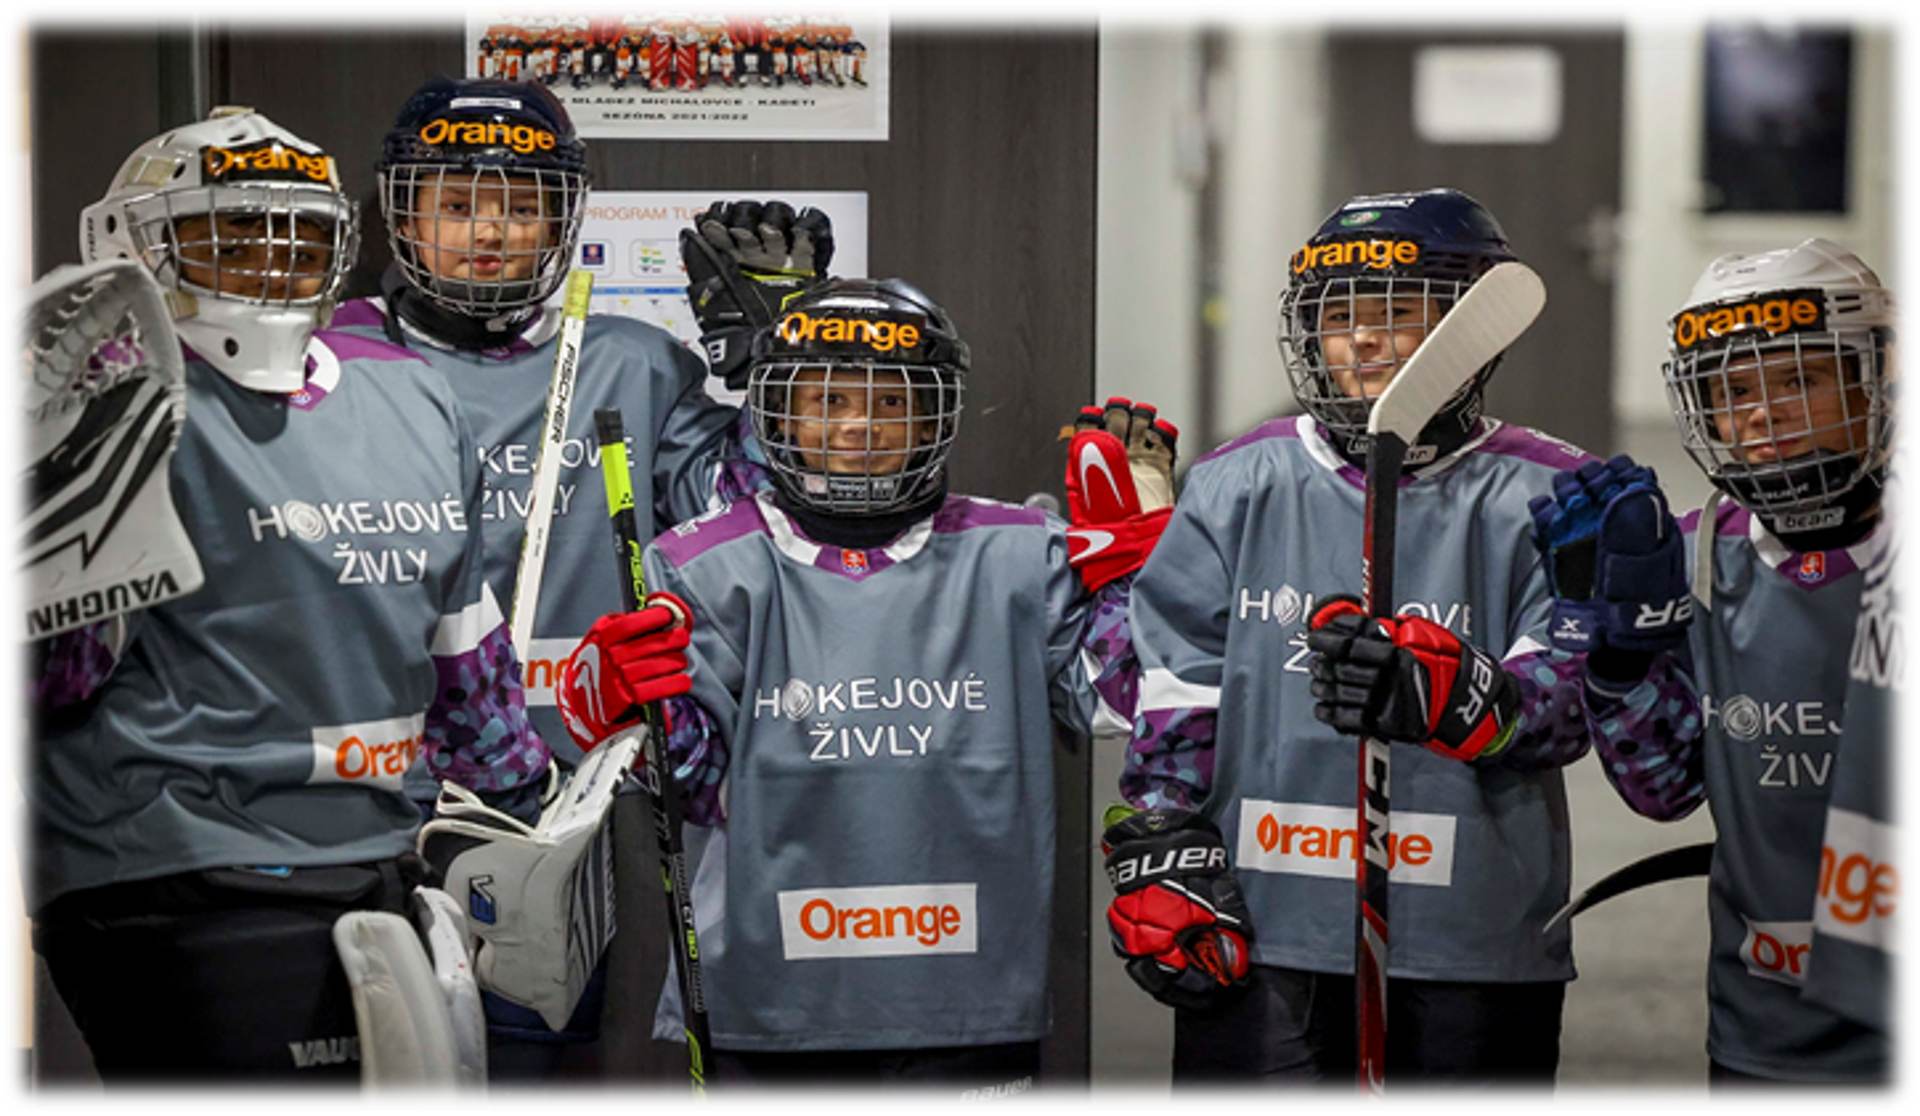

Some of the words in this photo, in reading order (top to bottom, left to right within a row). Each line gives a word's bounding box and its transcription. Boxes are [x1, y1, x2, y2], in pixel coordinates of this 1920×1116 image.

[419, 117, 555, 153] Orange
[585, 206, 667, 221] PROGRAM
[1291, 238, 1418, 272] Orange
[783, 312, 919, 350] Orange
[1675, 297, 1819, 347] Orange
[551, 342, 577, 443] FISCHER
[248, 493, 468, 543] HOKEJOVÉ
[333, 542, 428, 584] ŽIVLY
[27, 570, 180, 635] VAUGHN
[754, 672, 987, 722] HOKEJOVÉ
[808, 721, 932, 761] ŽIVLY
[1256, 812, 1434, 870] Orane
[799, 898, 961, 947] Orange
